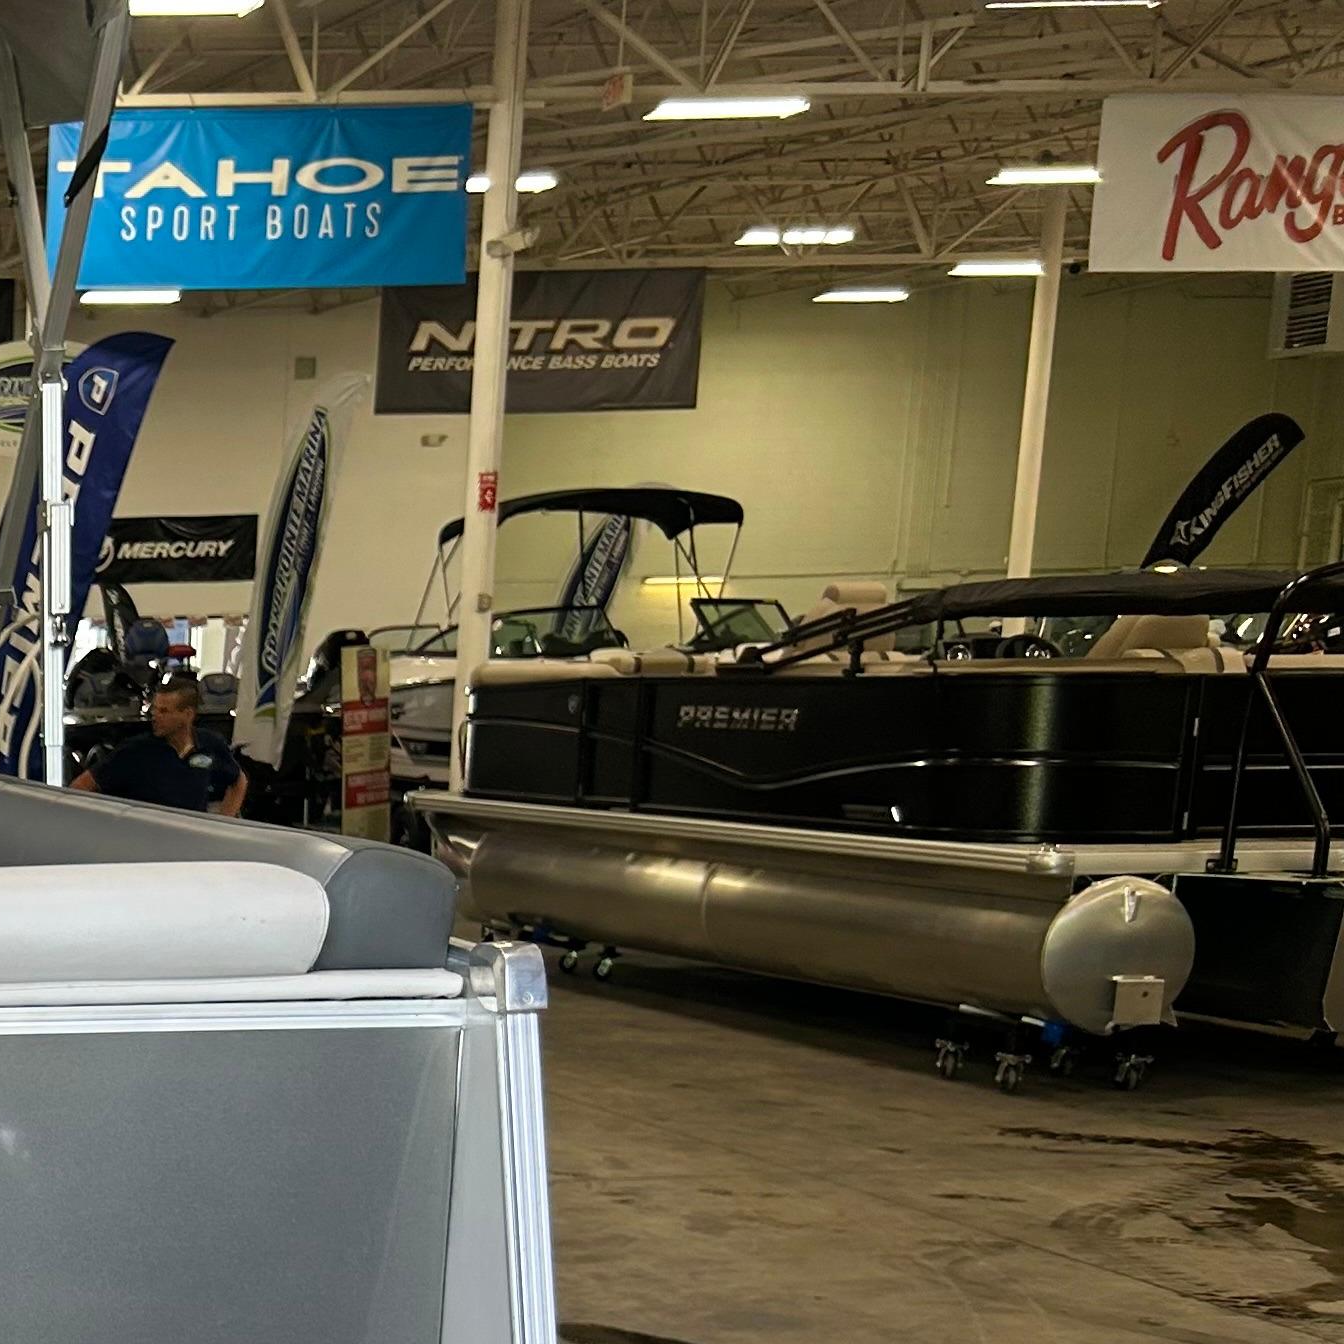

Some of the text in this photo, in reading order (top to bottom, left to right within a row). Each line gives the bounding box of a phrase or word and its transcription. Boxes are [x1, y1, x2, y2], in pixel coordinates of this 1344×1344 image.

[57, 155, 460, 199] TAHOE
[1157, 110, 1344, 261] Rang
[120, 202, 382, 241] SPORT BOATS
[409, 318, 677, 351] NTRO
[407, 352, 661, 372] PERFONCE BASS BOATS
[293, 405, 327, 500] MARINA
[1189, 432, 1282, 542] KINGFISHER
[116, 538, 236, 560] MERCURY
[676, 704, 800, 731] PREMIER
